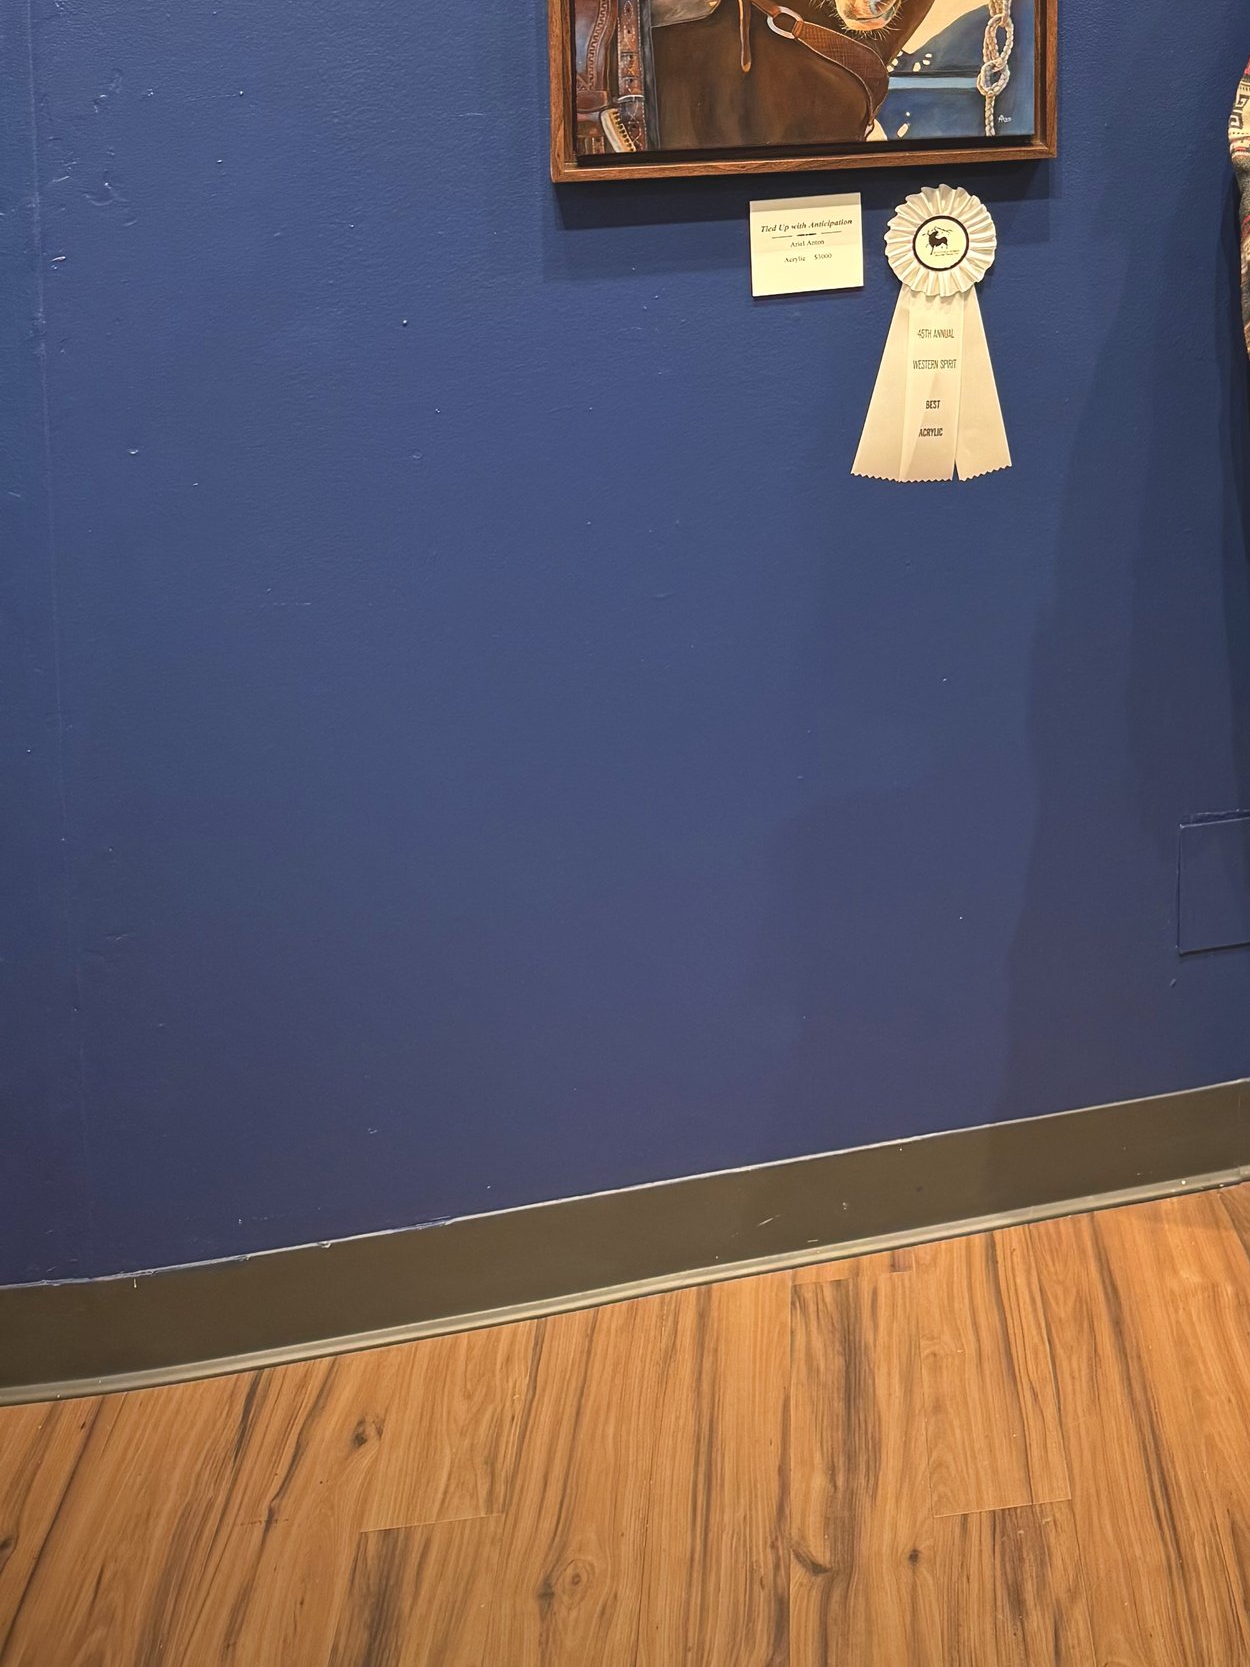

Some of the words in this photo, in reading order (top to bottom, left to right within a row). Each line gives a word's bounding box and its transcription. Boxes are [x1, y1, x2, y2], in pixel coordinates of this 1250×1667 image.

[761, 224, 777, 233] Tied
[778, 224, 789, 232] Up
[791, 222, 806, 230] with
[808, 218, 852, 229] Anticipation
[917, 328, 932, 339] 45TH
[912, 359, 939, 370] WESTERN
[940, 358, 957, 370] SPIRIT
[925, 399, 941, 410] BEST
[918, 427, 944, 437] ACRYLIC
